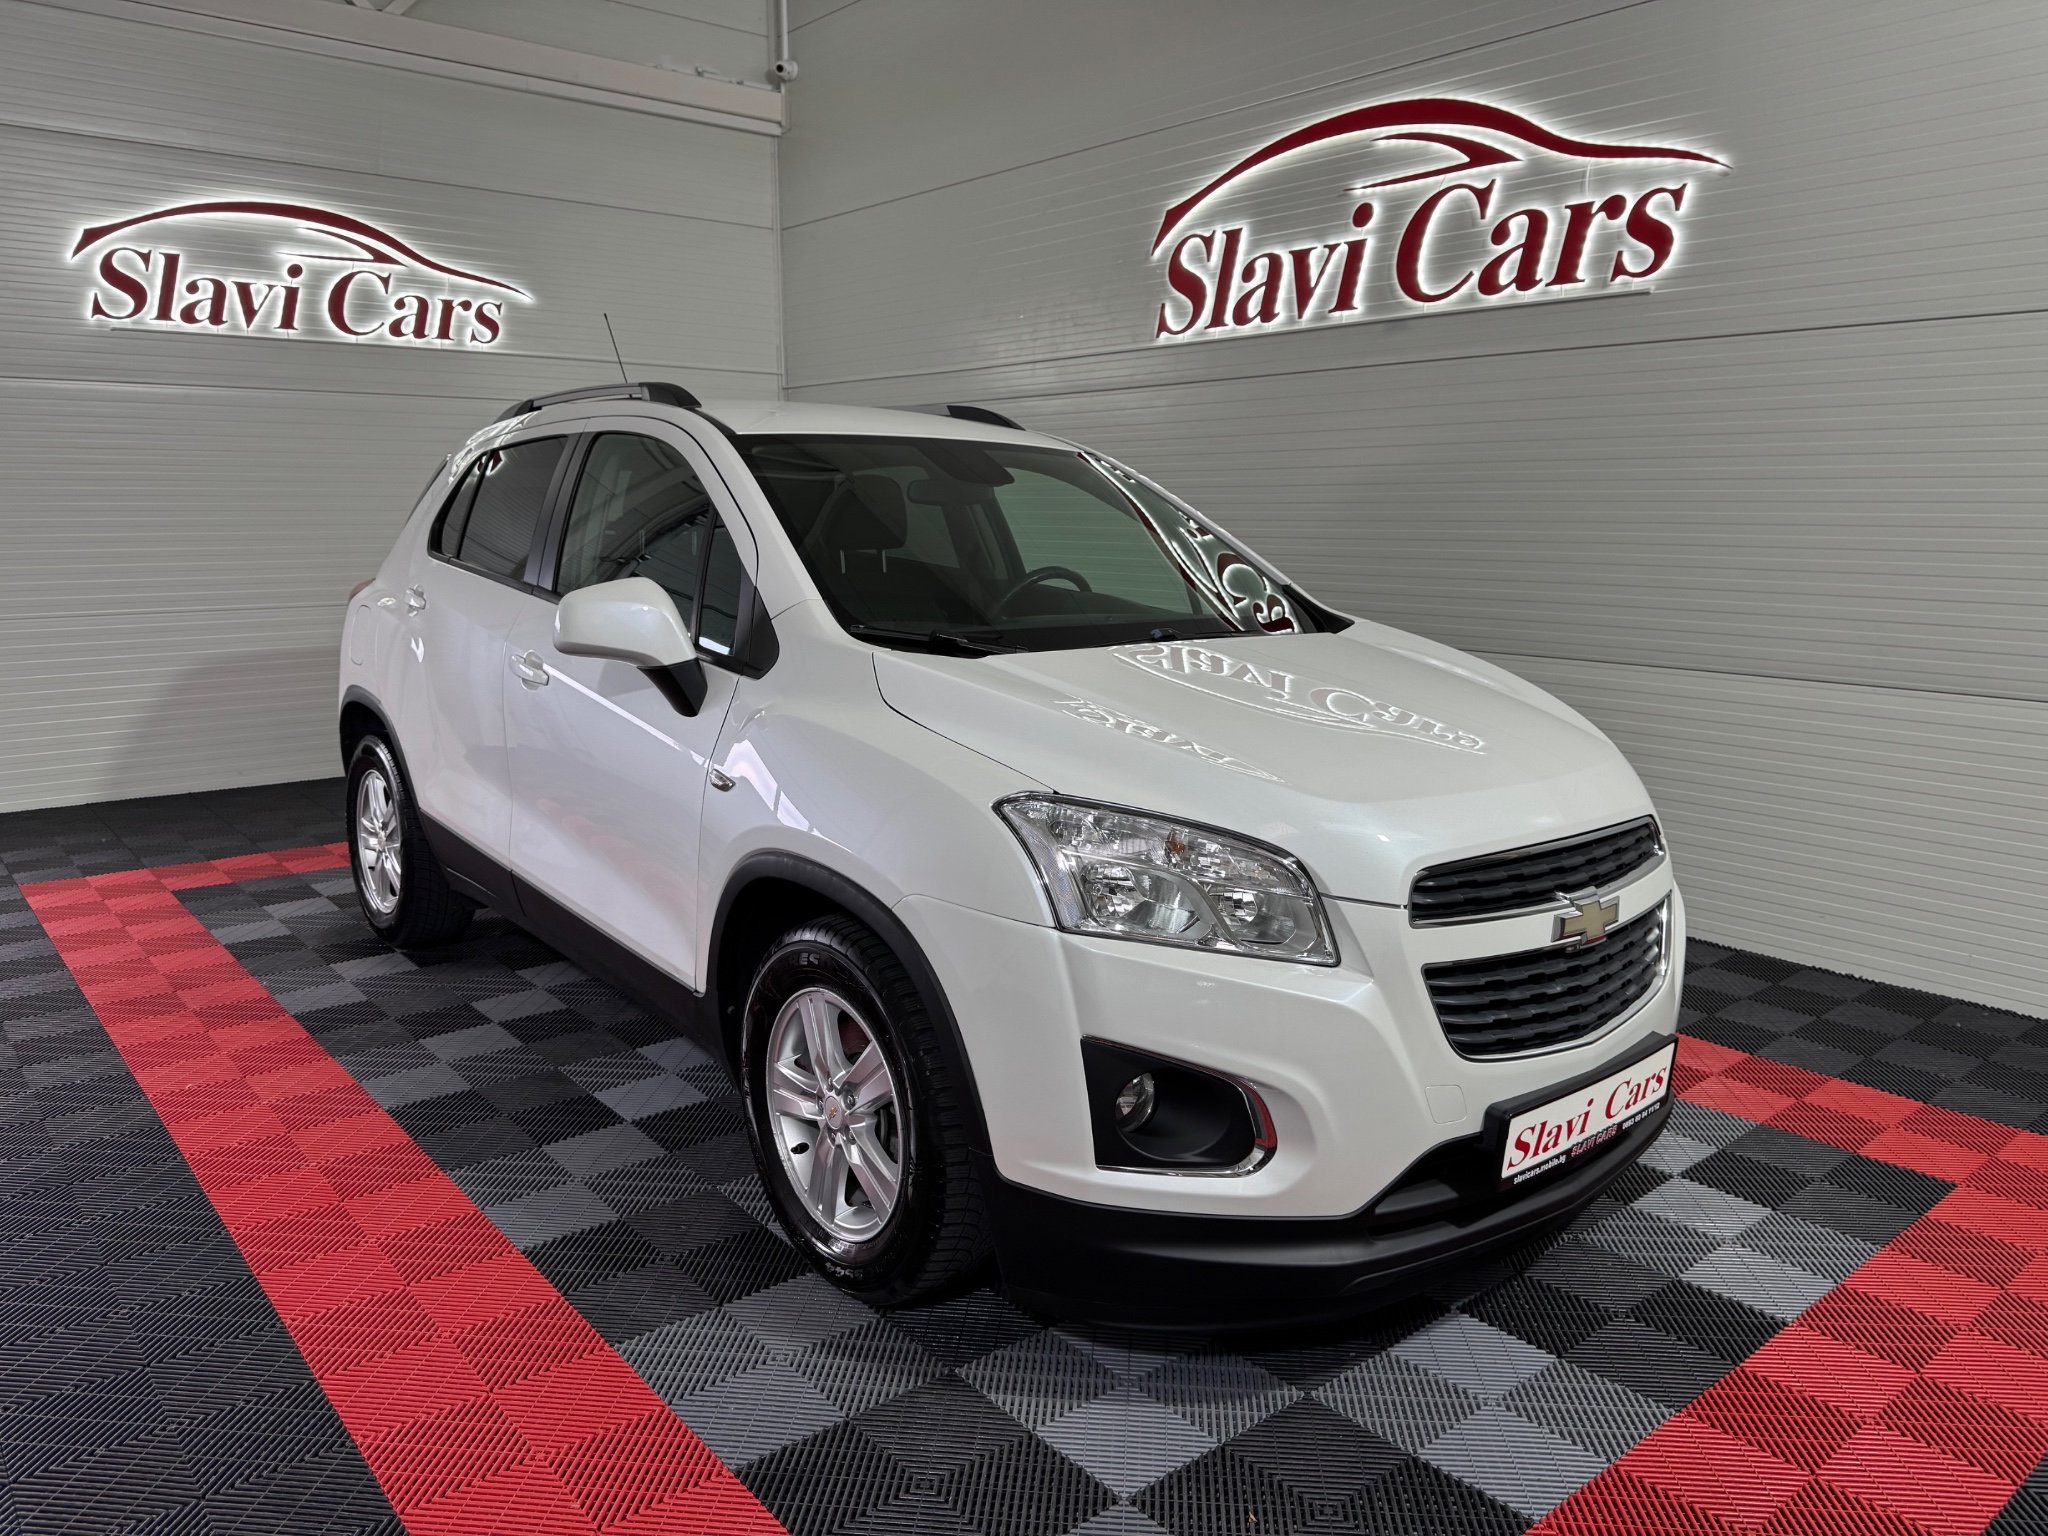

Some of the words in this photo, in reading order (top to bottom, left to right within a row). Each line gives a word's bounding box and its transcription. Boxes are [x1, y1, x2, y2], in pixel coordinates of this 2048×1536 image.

[91, 247, 303, 331] Slavi
[327, 270, 502, 344] Cars
[1156, 202, 1374, 339] Slavi
[1396, 178, 1688, 303] Cars
[1507, 1098, 1594, 1171] Slavi
[1605, 1066, 1667, 1119] Cars
[1513, 1154, 1567, 1185] slavicars.mobile.bg
[1570, 1135, 1595, 1158] SLAVI
[1595, 1123, 1617, 1146] CARS
